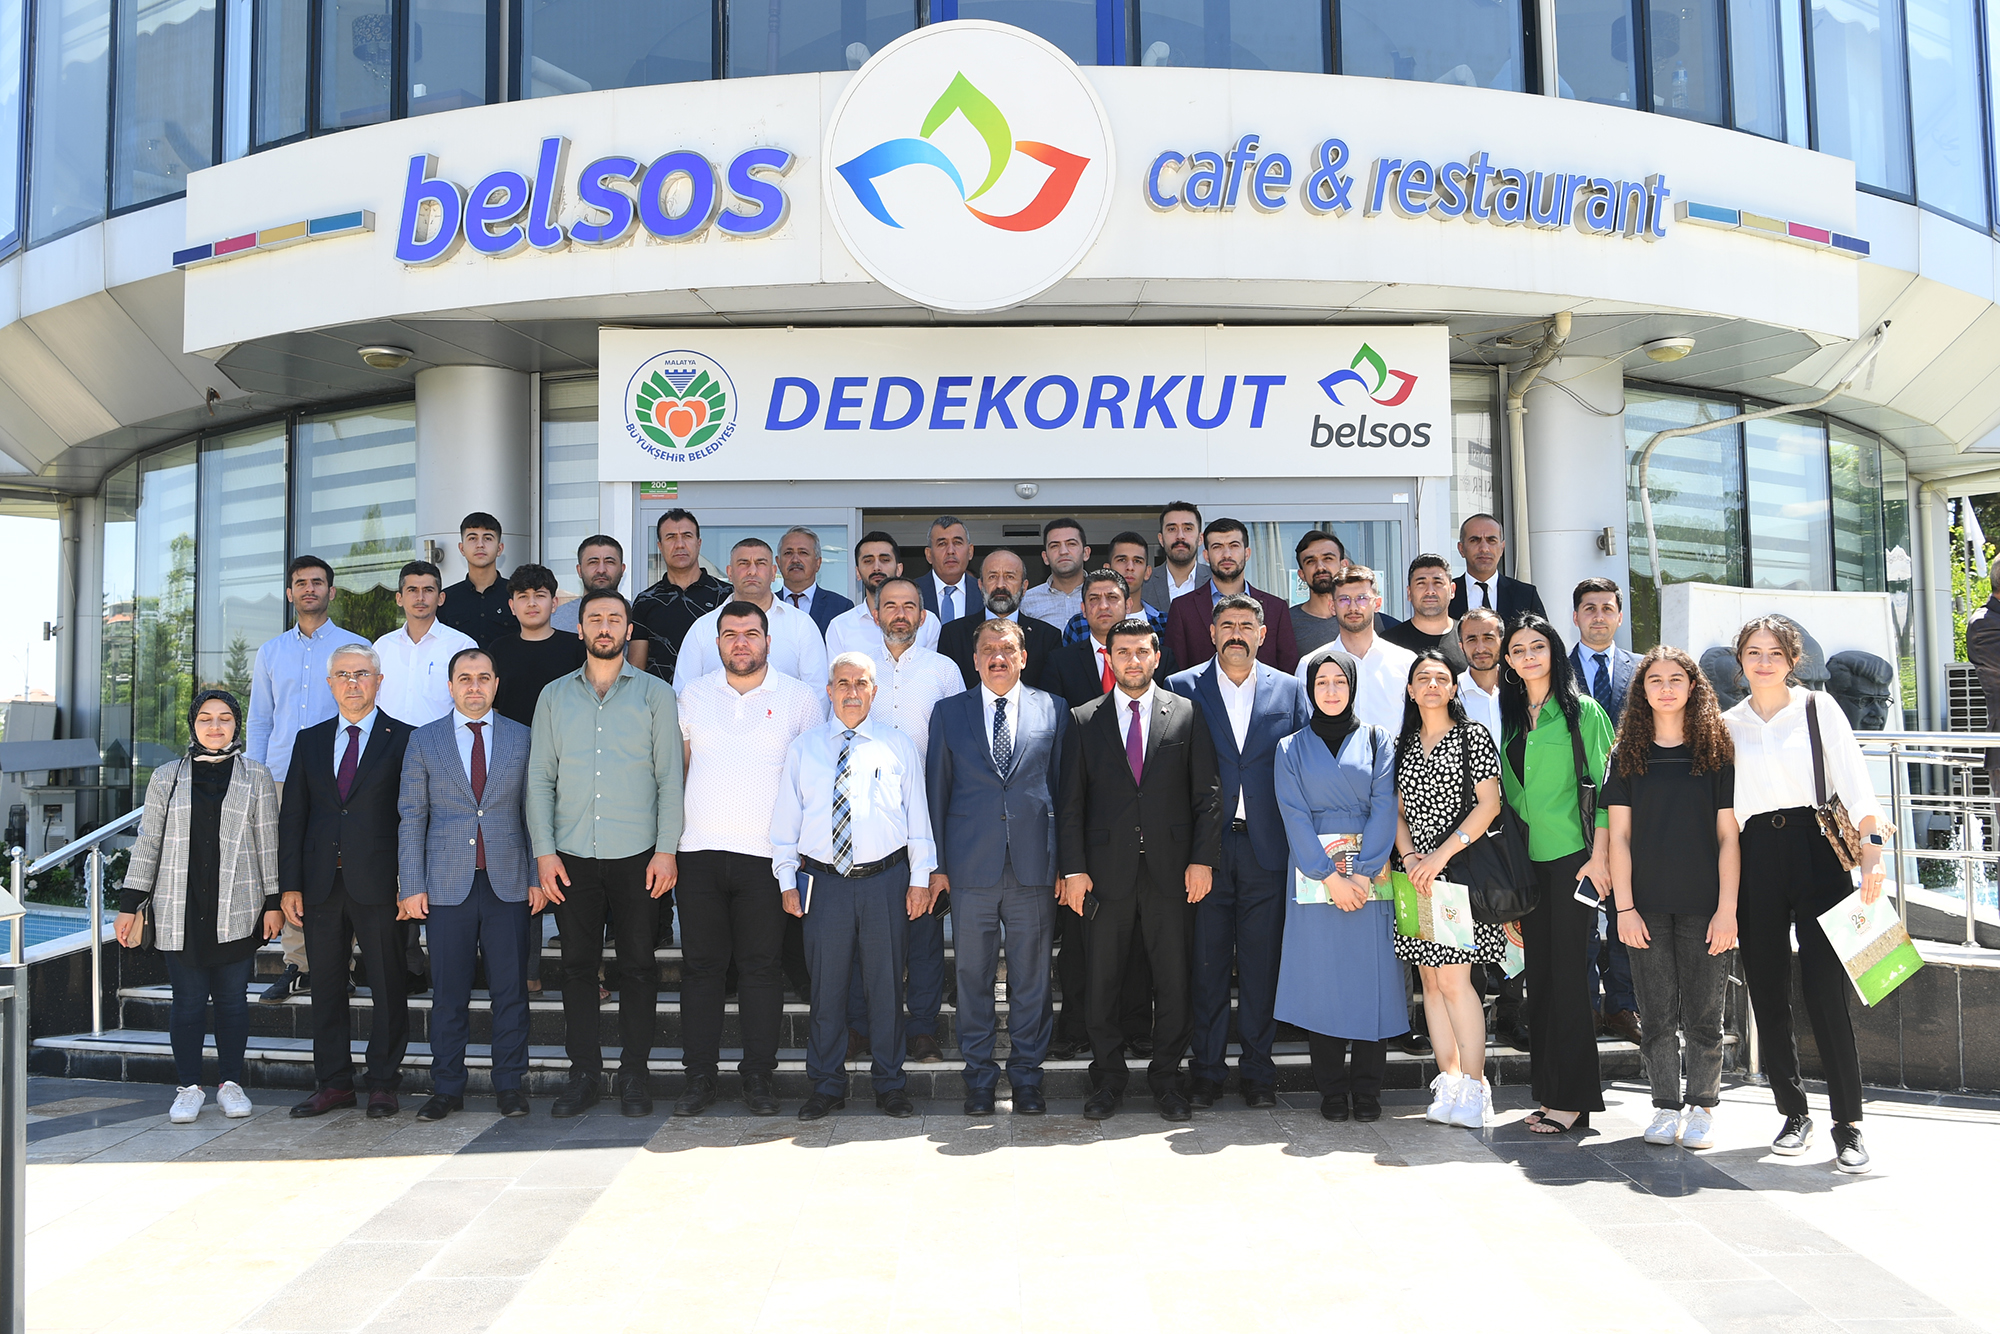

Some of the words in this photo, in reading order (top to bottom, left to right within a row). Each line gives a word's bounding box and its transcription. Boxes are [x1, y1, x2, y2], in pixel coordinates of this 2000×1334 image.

[393, 134, 797, 267] belsos
[1142, 132, 1293, 214] cafe
[1300, 137, 1355, 218] &
[1363, 150, 1671, 243] restaurant
[764, 374, 1287, 432] DEDEKORKUT
[625, 422, 686, 463] BÜYÜKŞEHİR
[688, 420, 737, 462] BELEDİYESİ
[1310, 414, 1432, 448] belsos
[651, 481, 667, 489] 200
